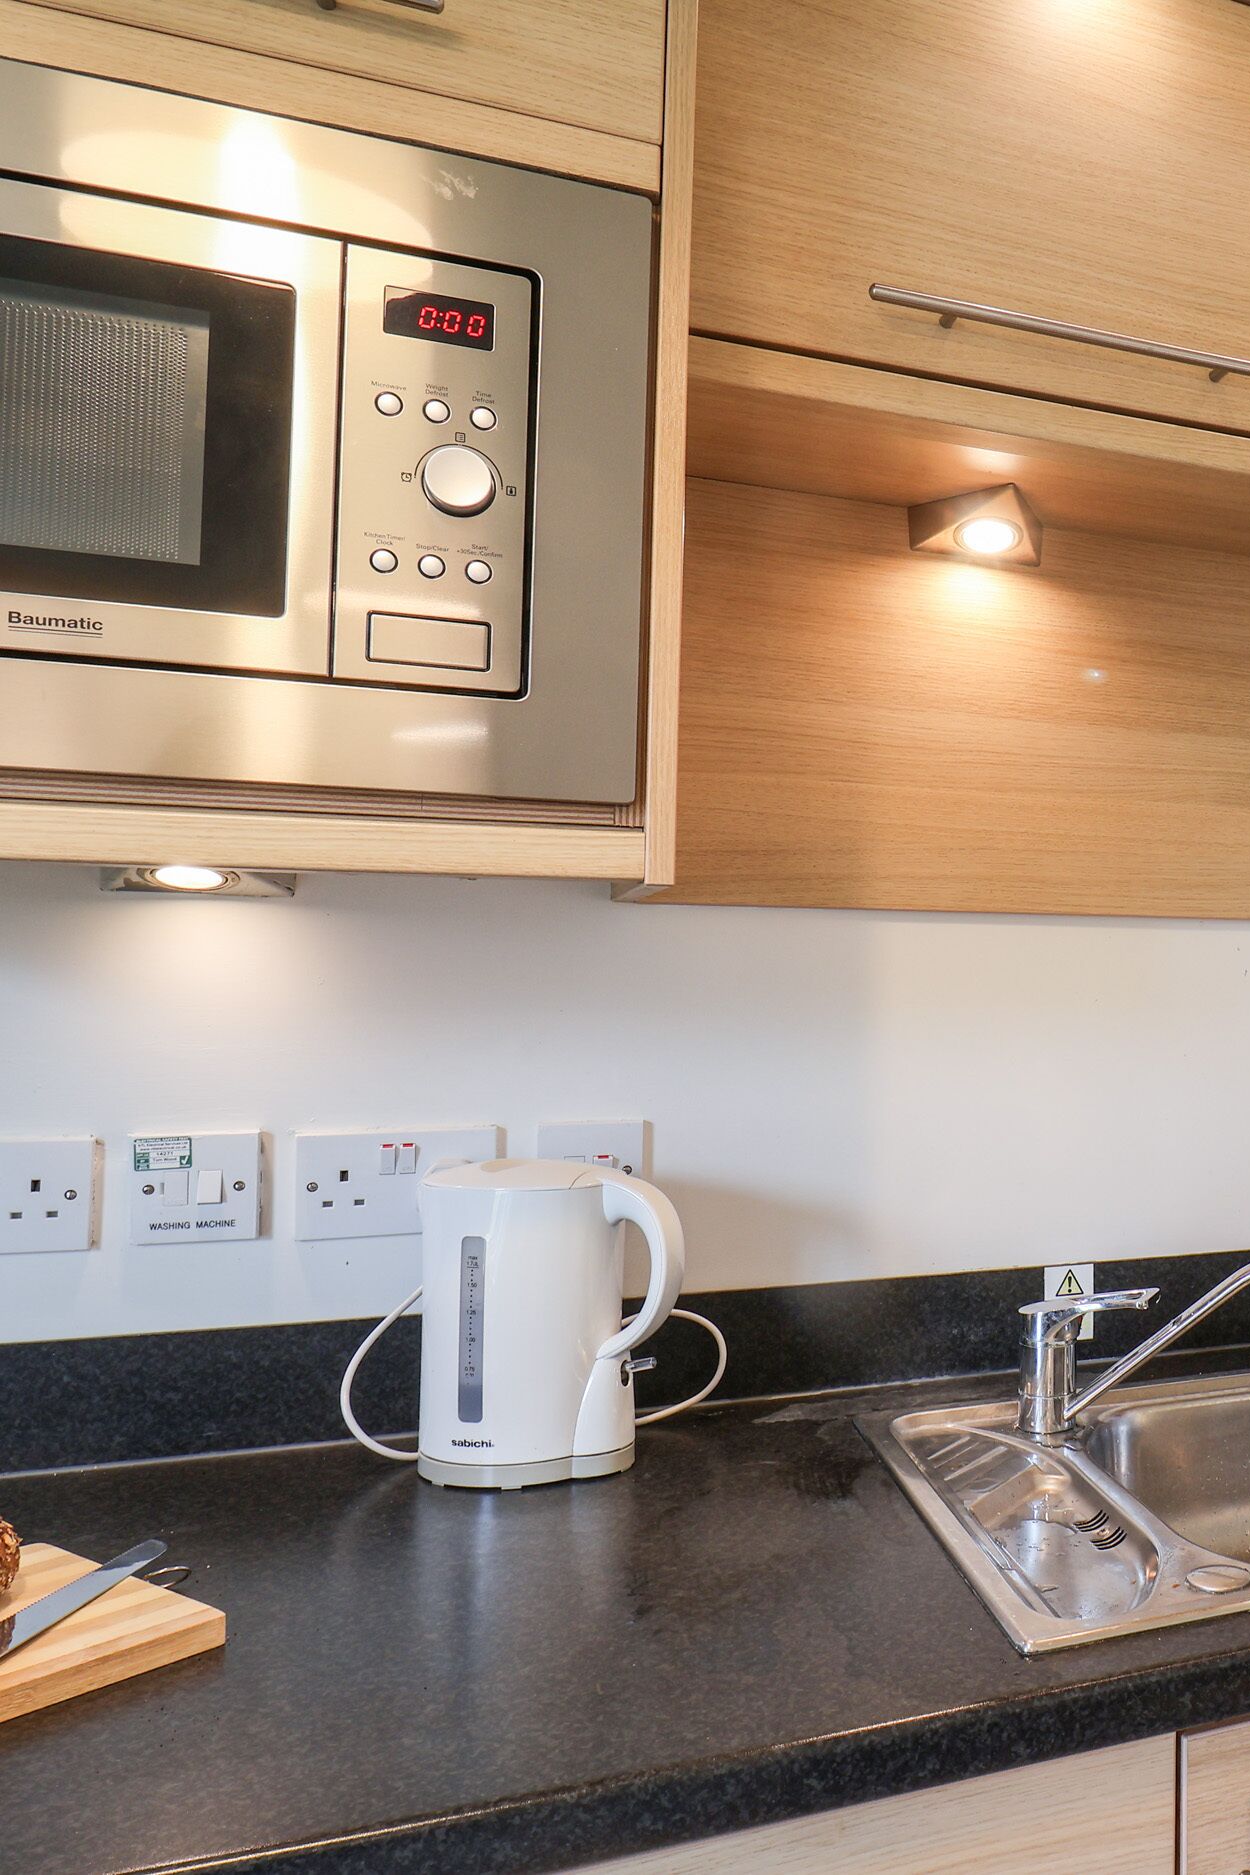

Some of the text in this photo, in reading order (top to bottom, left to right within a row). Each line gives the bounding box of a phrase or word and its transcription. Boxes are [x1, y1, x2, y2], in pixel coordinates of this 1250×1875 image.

[418, 306, 486, 337] 0:00
[8, 610, 104, 631] Baumatic
[149, 1218, 236, 1231] WASHING MACHINE
[451, 1438, 492, 1448] sabichi
